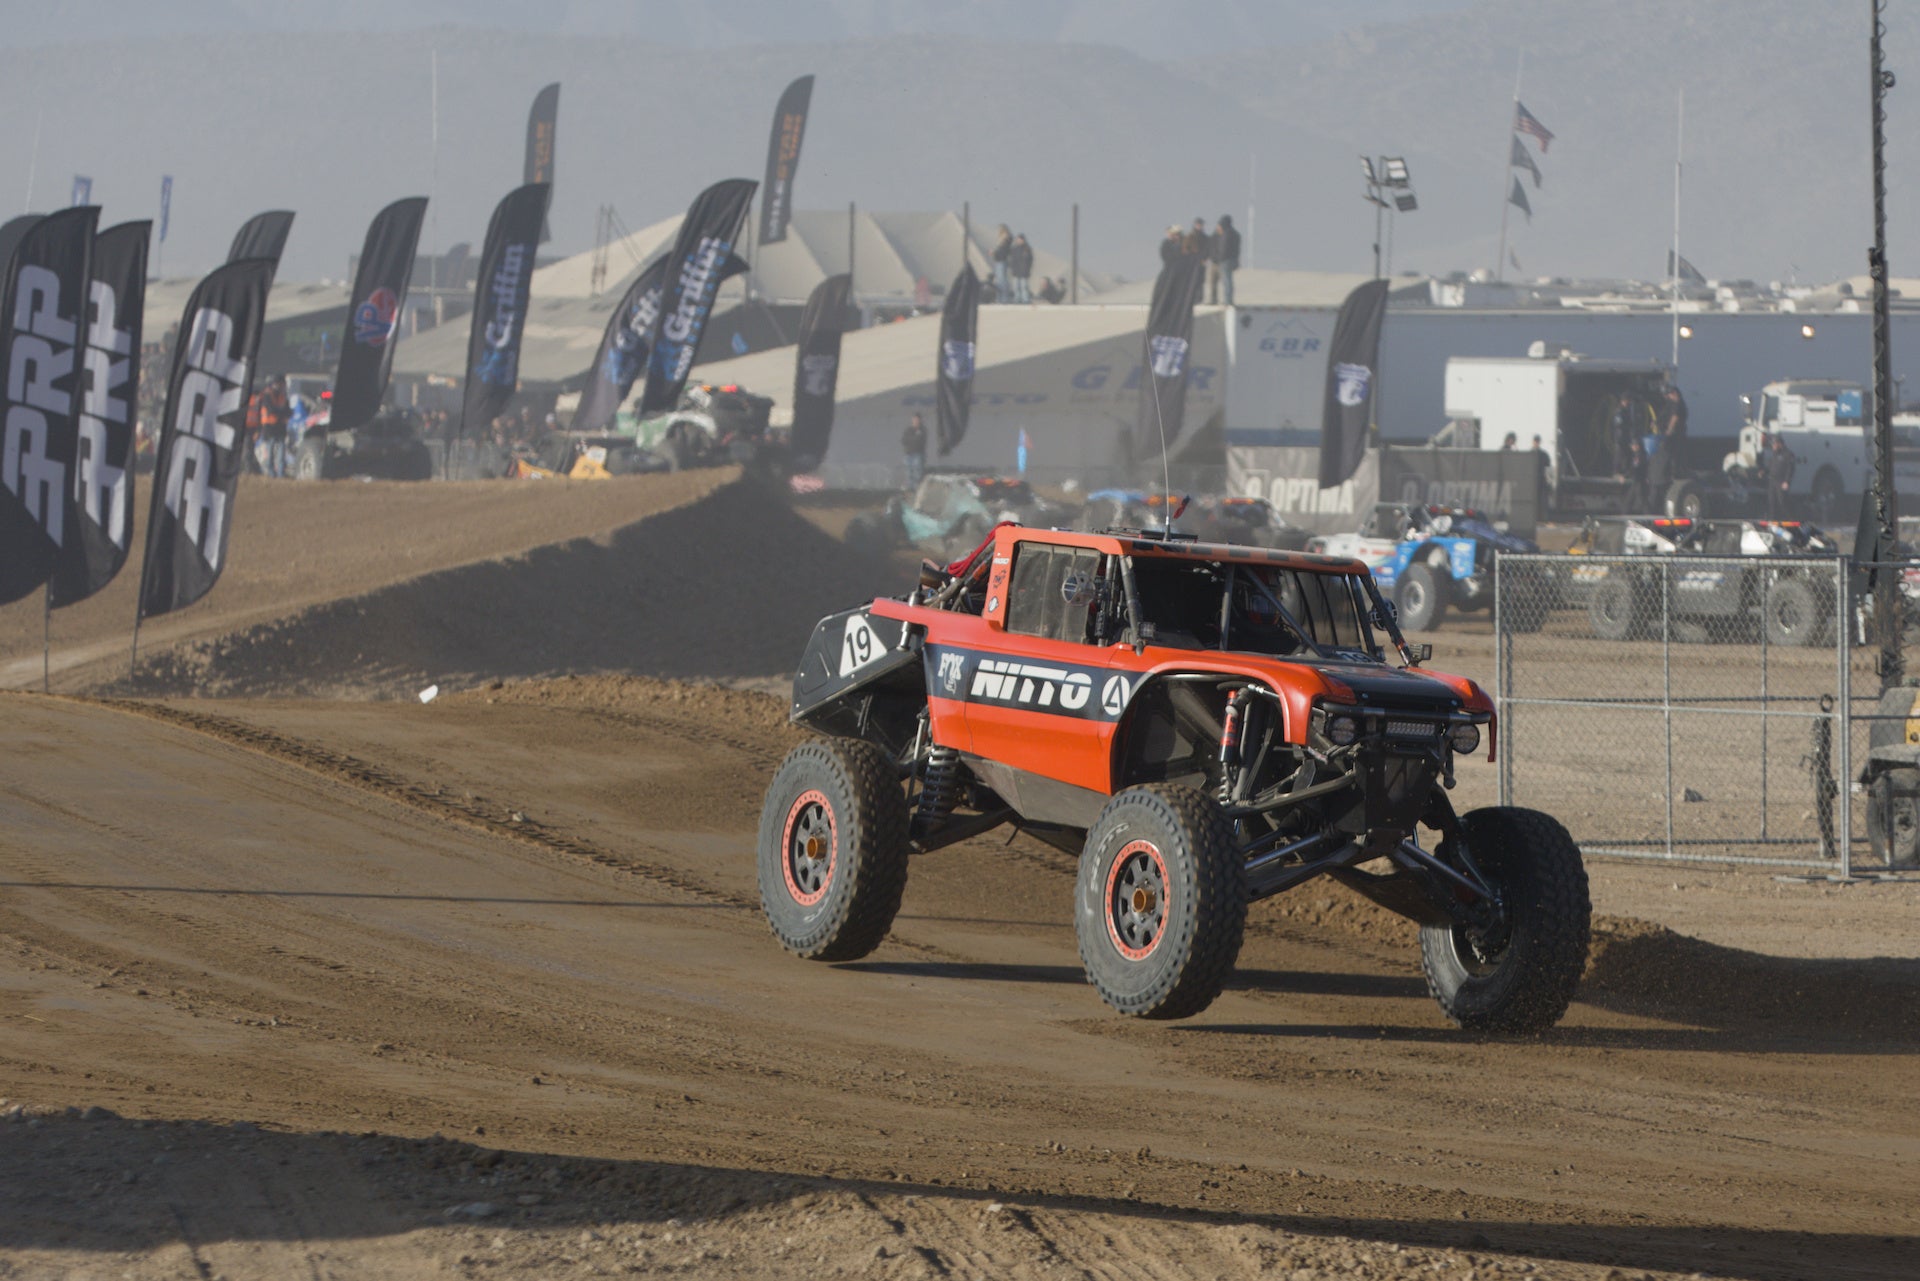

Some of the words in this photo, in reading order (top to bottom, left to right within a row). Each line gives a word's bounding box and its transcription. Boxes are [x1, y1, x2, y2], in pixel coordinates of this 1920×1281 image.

[1259, 337, 1321, 351] GBR
[4, 264, 76, 548] PRP
[75, 280, 131, 550] PRP
[165, 308, 246, 571] PRP
[1271, 477, 1354, 513] OPTIMA
[845, 625, 872, 666] 19
[938, 653, 964, 690] FOX
[971, 659, 1092, 710] NITTO
